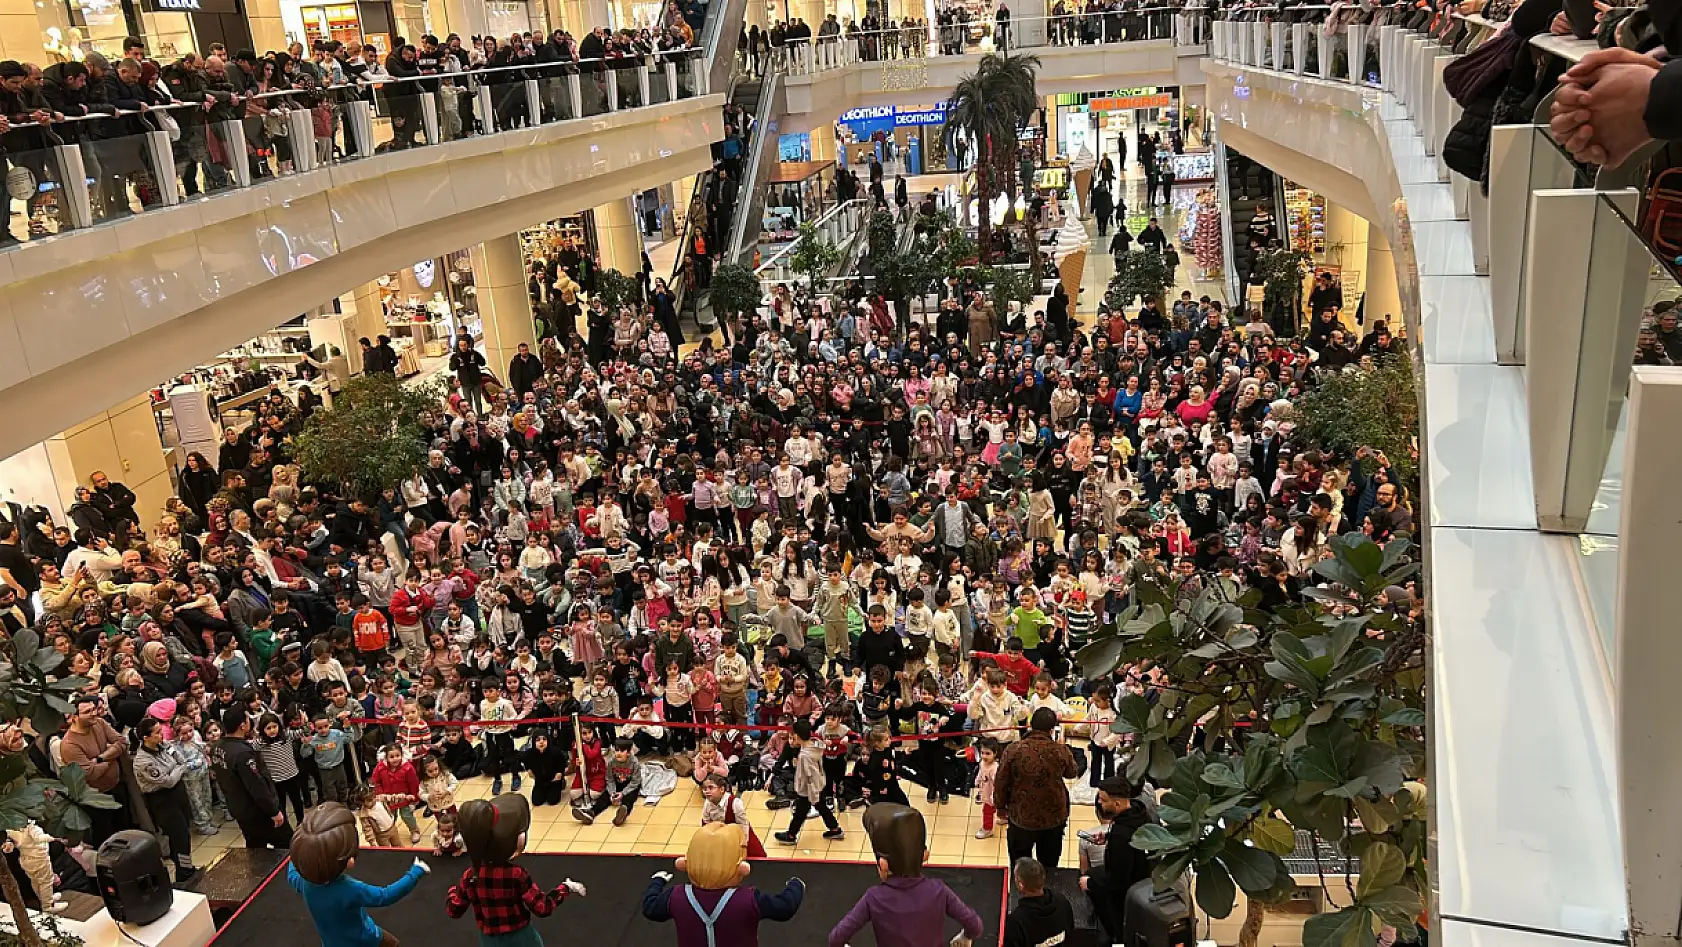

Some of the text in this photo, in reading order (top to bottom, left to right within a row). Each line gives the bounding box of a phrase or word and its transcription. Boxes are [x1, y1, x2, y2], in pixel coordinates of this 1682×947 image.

[1116, 95, 1168, 109] MIGROS
[842, 105, 892, 120] DECATHLON
[895, 112, 942, 124] DECATHLON
